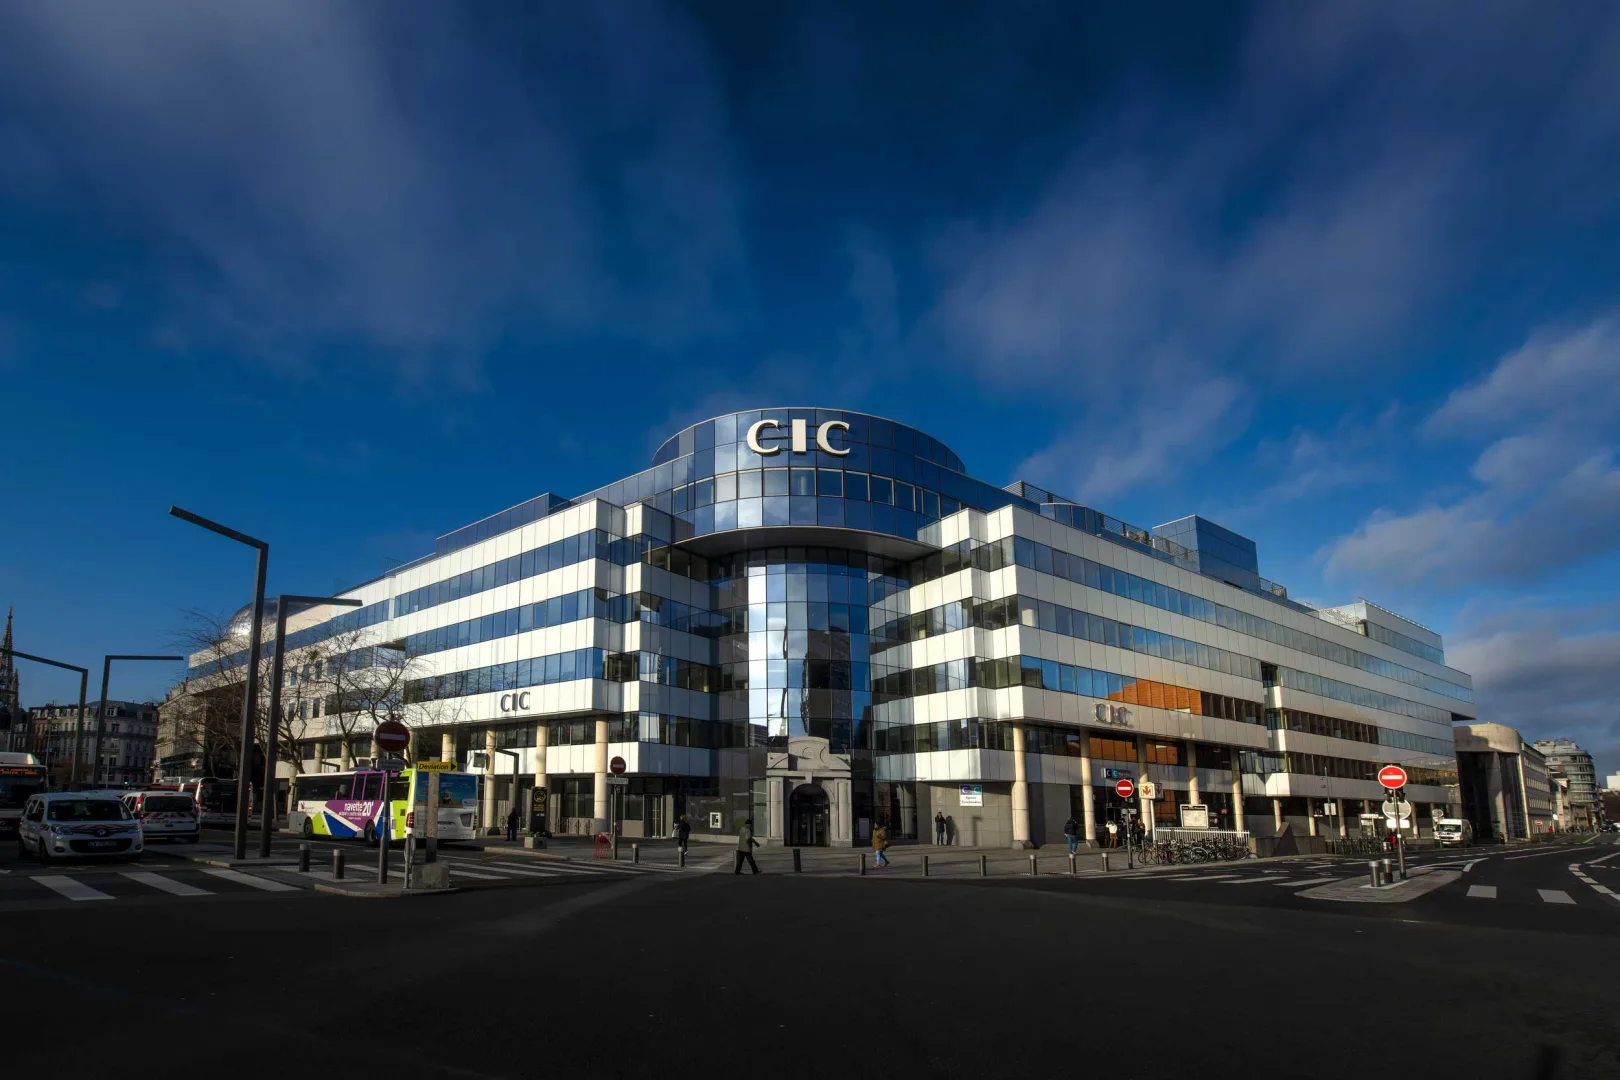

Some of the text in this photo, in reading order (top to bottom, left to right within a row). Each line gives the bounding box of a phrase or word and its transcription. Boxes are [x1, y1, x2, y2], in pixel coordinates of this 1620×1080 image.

[746, 418, 851, 455] CIC
[500, 691, 531, 712] CIC
[344, 802, 363, 812] navette
